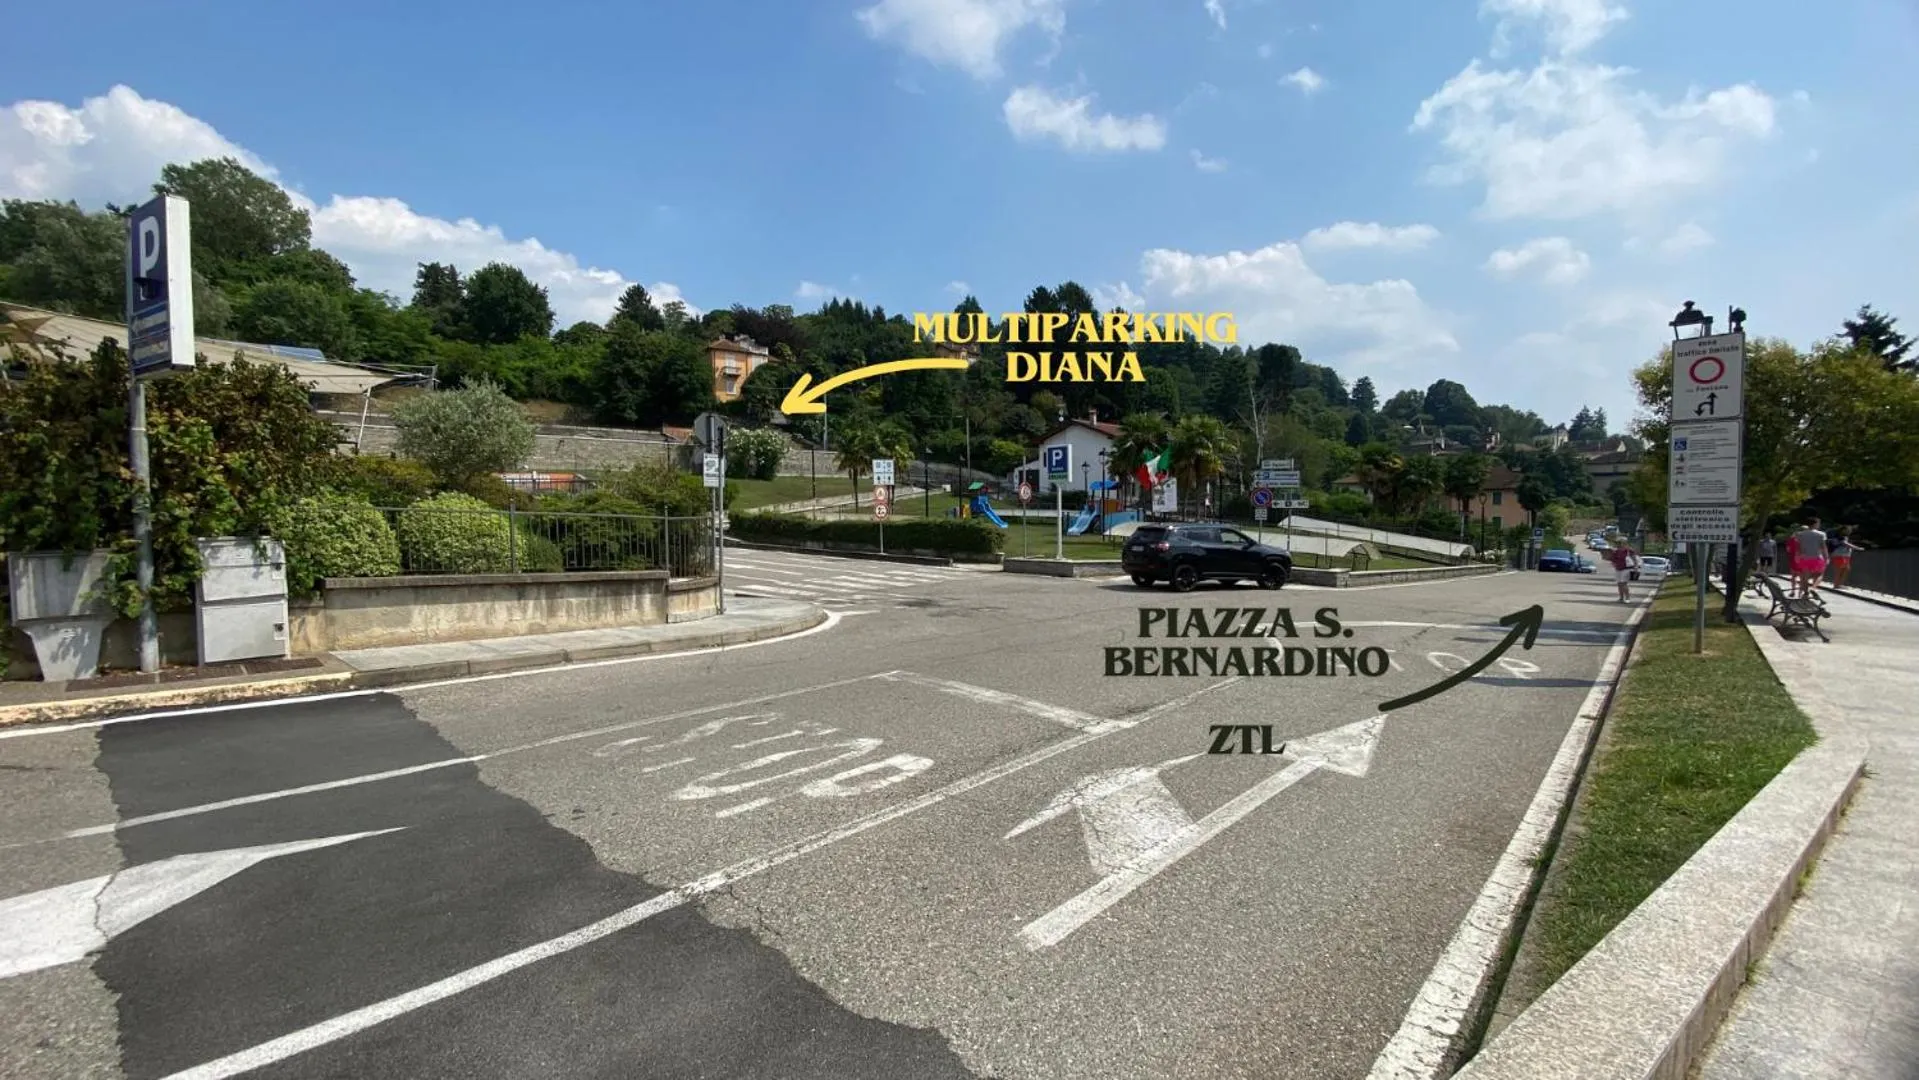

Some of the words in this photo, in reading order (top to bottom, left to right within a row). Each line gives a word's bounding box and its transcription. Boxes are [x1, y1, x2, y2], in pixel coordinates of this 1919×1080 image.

[139, 216, 160, 301] P
[1052, 449, 1064, 467] P
[1679, 508, 1725, 516] controllo
